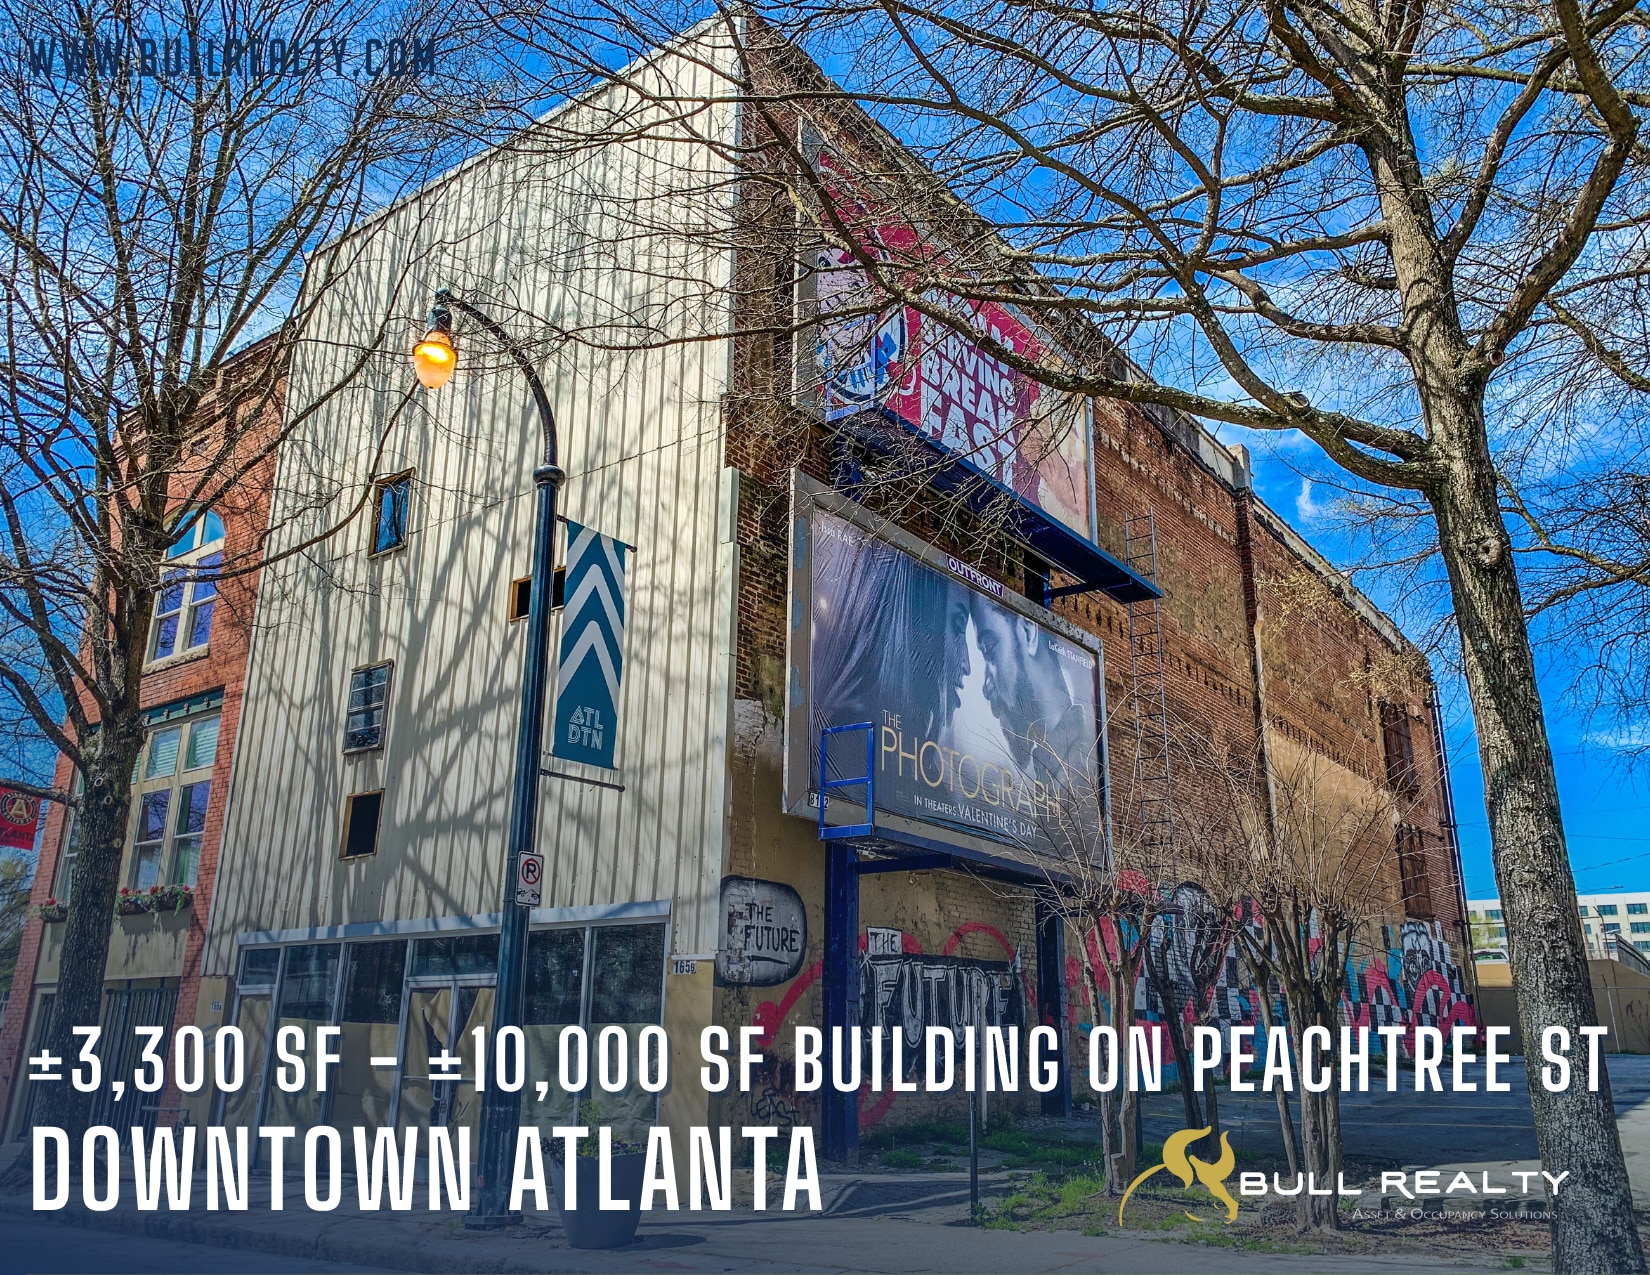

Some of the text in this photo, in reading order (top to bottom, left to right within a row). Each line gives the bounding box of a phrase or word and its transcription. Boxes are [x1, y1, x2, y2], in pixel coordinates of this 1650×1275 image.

[920, 349, 1017, 446] BREAK
[920, 379, 1018, 490] FAST
[947, 557, 1002, 596] OUTFRONT
[569, 704, 604, 731] ATL
[883, 709, 902, 730] THE
[567, 723, 604, 751] DTN
[881, 725, 1061, 823] PHOTOGRAPH
[914, 794, 923, 806] IN
[924, 797, 957, 817] THEATERS
[957, 802, 1018, 834] VALENTINE'S
[1019, 821, 1037, 839] DAY
[745, 902, 773, 923] THE
[744, 925, 800, 953] FUTURE
[869, 931, 899, 953] THE
[868, 958, 1013, 1048] FUTURE
